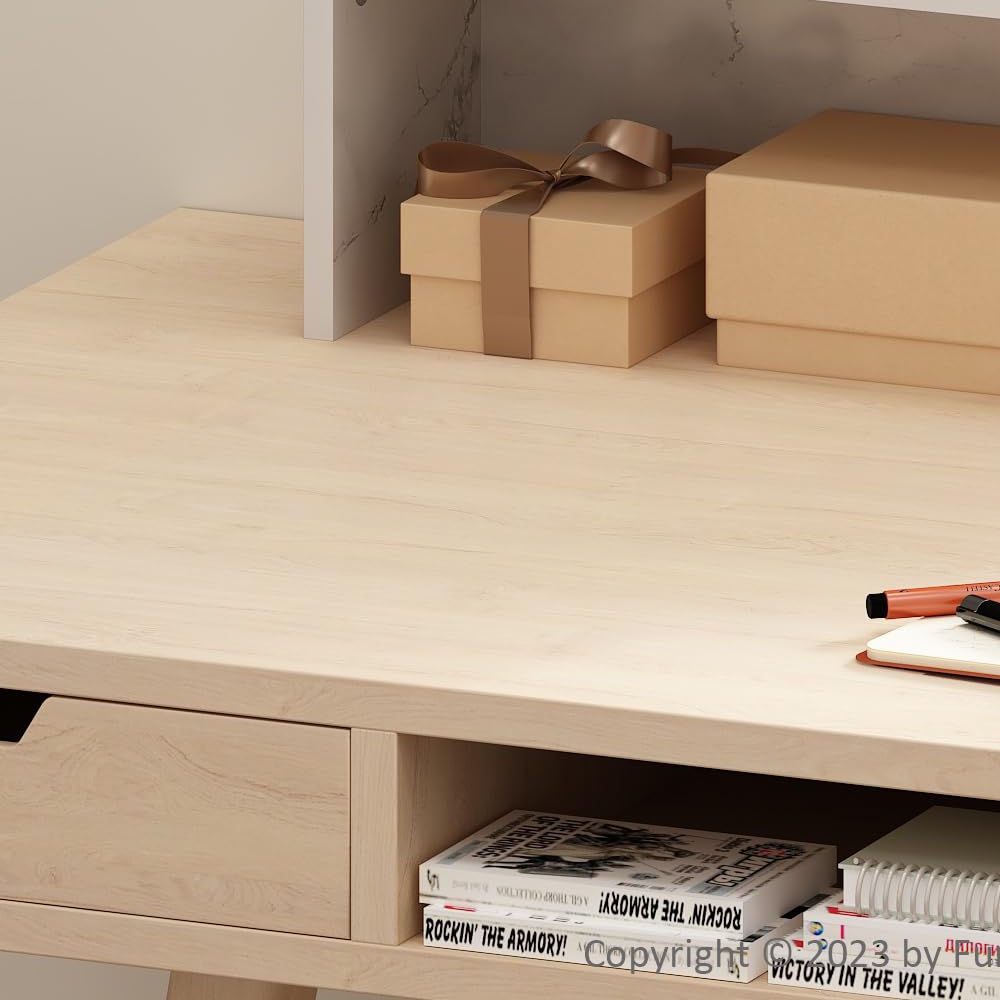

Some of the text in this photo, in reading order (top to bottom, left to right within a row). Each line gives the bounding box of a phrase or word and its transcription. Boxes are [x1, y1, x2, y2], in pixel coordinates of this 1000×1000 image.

[524, 831, 568, 849] LORD
[598, 891, 742, 931] ROCKIN' THE ARMORY!
[425, 918, 478, 945] ROCKIN'
[481, 925, 505, 949] THE
[507, 928, 567, 957] ARMORY!
[772, 957, 965, 1000] VICTORY IN THE VALLEY!
